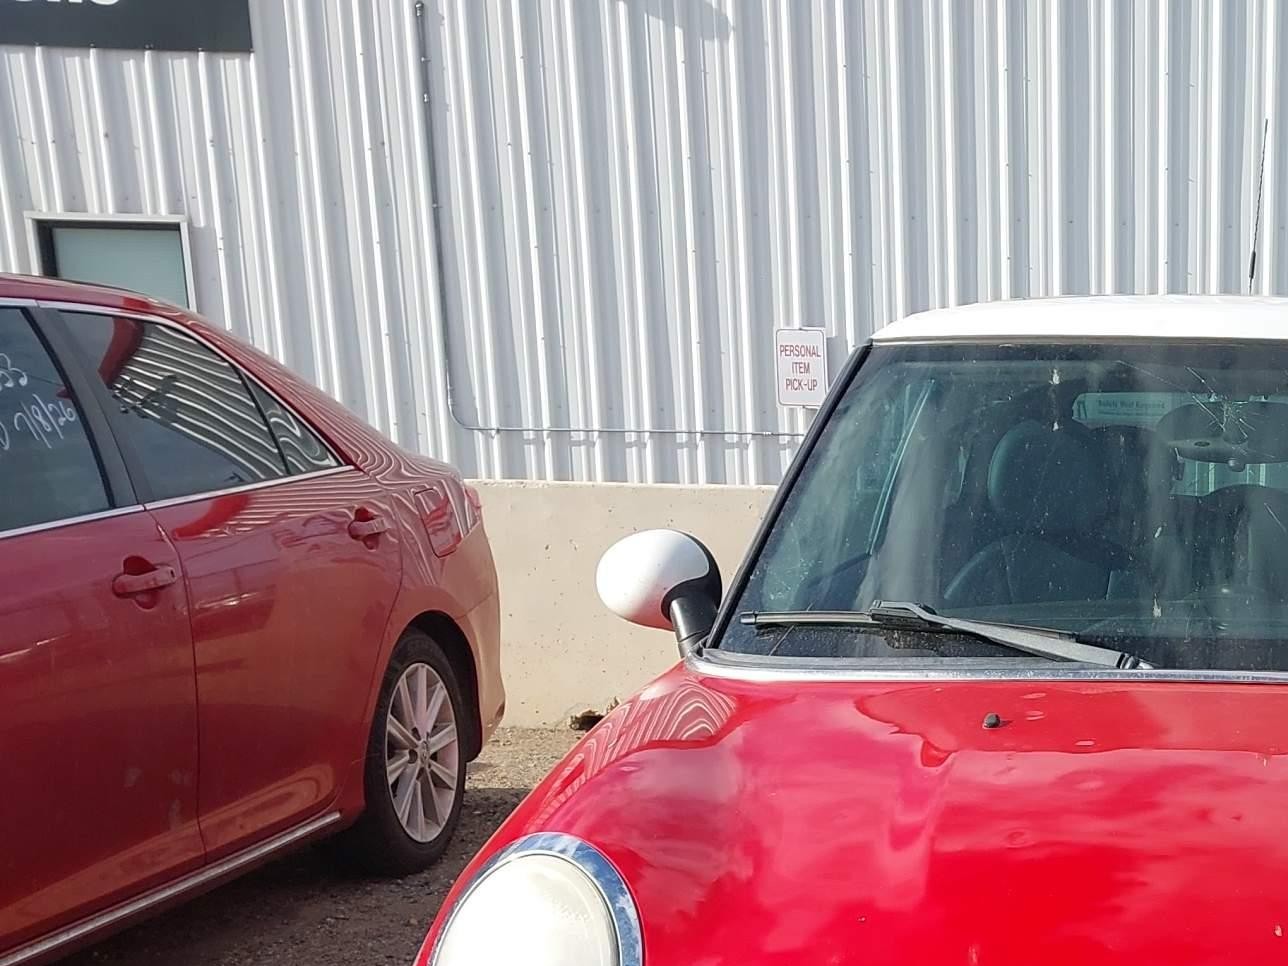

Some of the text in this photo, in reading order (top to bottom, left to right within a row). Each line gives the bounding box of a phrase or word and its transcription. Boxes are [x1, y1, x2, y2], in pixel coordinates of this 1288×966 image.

[779, 344, 821, 358] PERSONAL
[791, 361, 811, 374] ITEM
[785, 378, 818, 391] PICK-UP
